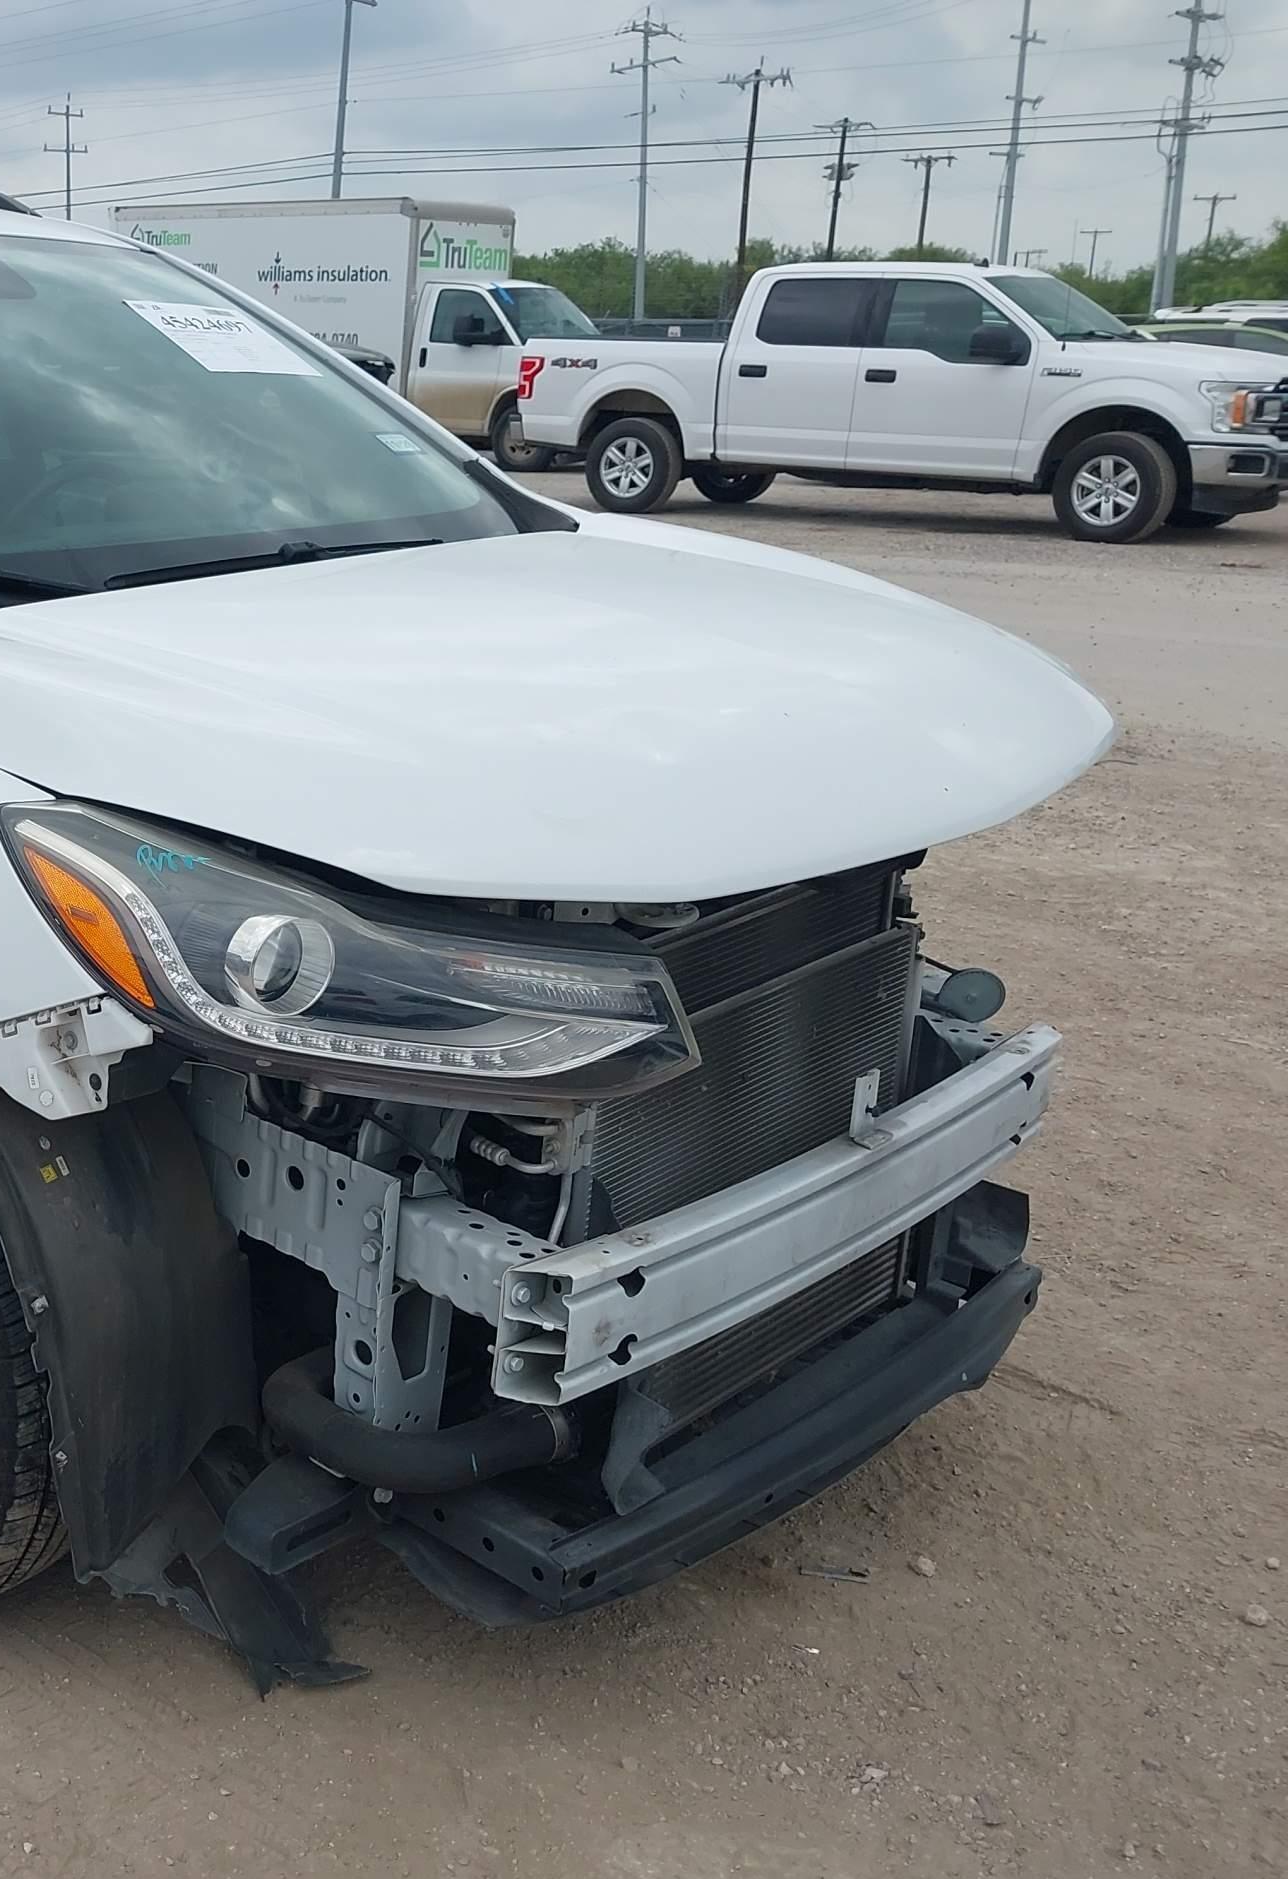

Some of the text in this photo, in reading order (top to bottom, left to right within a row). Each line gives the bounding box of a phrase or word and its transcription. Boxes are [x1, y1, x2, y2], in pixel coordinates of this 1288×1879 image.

[145, 230, 191, 246] TruTeam
[443, 237, 508, 271] TruTeam
[257, 265, 313, 282] williams
